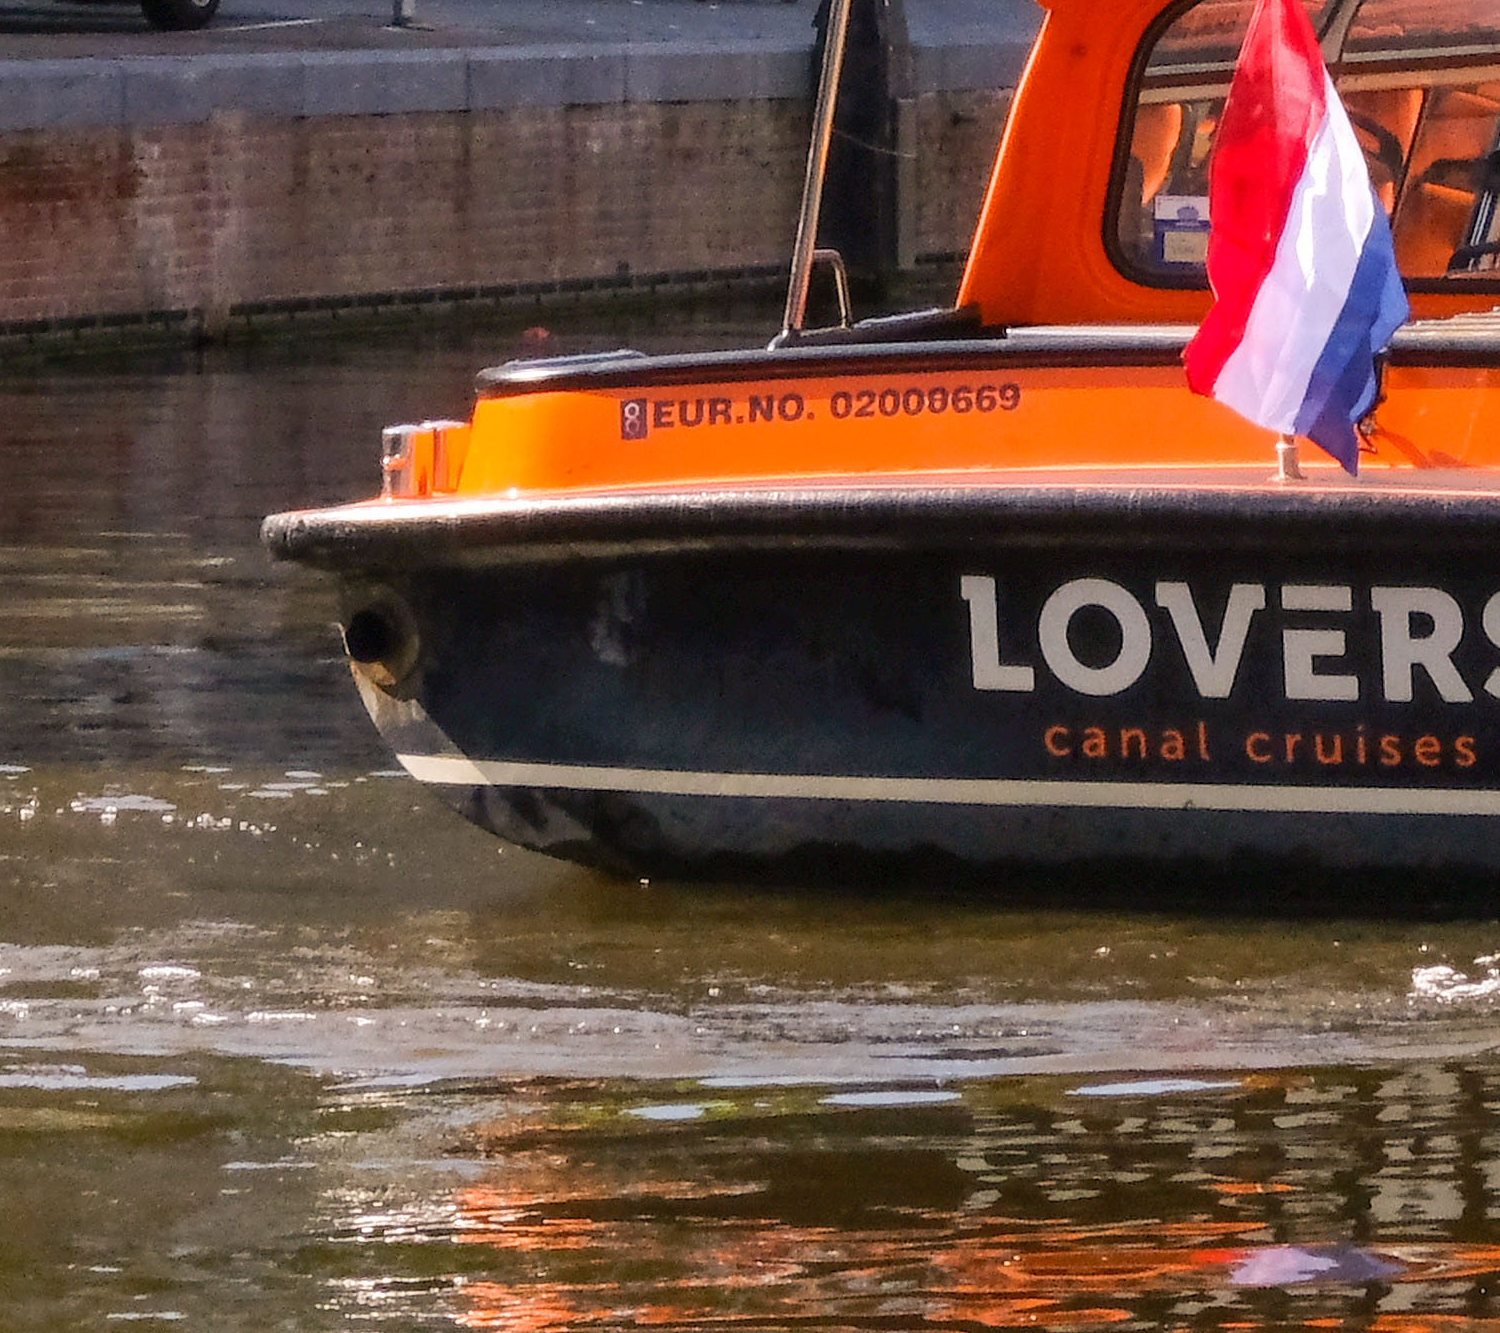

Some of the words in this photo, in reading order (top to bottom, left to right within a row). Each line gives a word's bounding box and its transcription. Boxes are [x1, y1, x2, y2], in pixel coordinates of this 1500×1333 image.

[830, 383, 1021, 419] 02008669
[1044, 722, 1210, 761] canal
[1245, 726, 1477, 767] cruises
